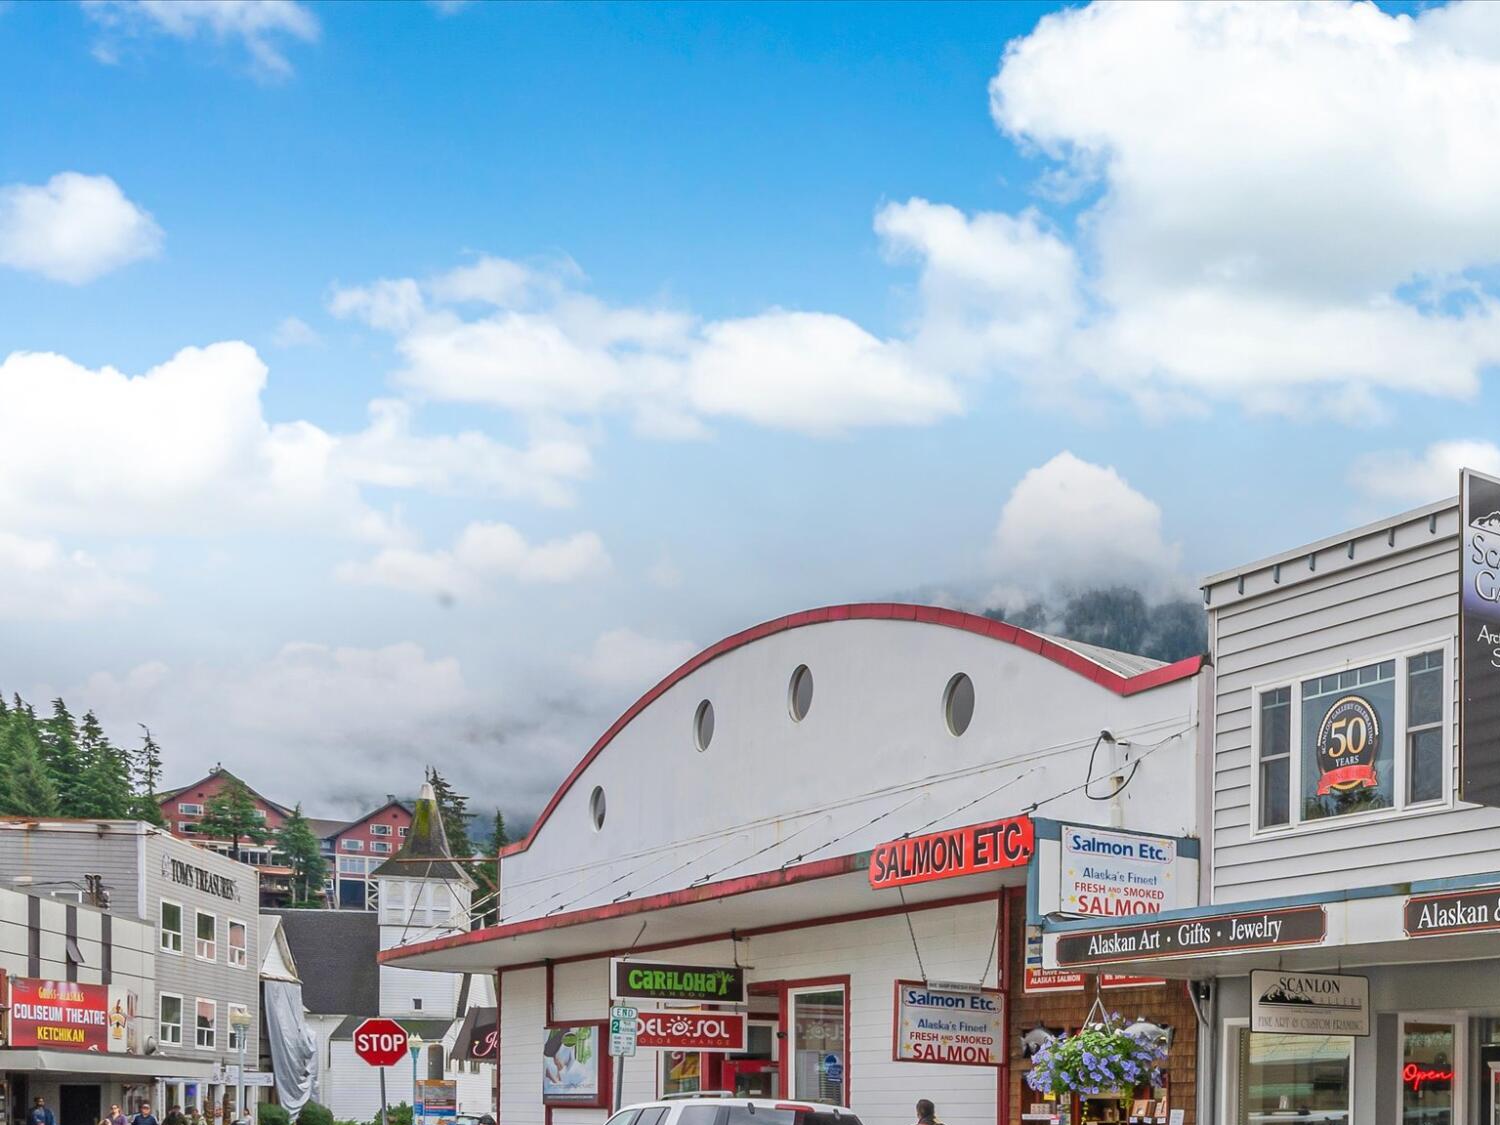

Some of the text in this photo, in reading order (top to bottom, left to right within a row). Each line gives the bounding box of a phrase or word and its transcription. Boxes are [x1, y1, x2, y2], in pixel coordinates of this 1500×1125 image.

[1328, 717, 1367, 757] 50
[1336, 755, 1360, 767] YEARS
[874, 822, 1030, 883] SALMON ETC.
[1072, 835, 1167, 861] Salmon Etc.
[171, 858, 234, 901] TOM'S TREASURES
[1083, 867, 1157, 885] Alaska's Finest
[1075, 882, 1105, 893] FRESH
[1124, 887, 1164, 900] SMOKED
[1078, 895, 1160, 916] SALMON
[1417, 902, 1489, 930] Alaskan
[1088, 916, 1282, 955] Alaskan Art Gifts Jewelry
[1280, 977, 1341, 993] SCANLON
[908, 991, 996, 1011] Salmon Etc.
[14, 1003, 105, 1025] COLISEUM THEATRE
[616, 1009, 634, 1017] END
[37, 1026, 85, 1042] KETCHIKAN
[693, 1020, 729, 1038] SOL
[917, 1019, 987, 1032] Alaska's Finest
[358, 1034, 404, 1052] STOP
[910, 1032, 938, 1041] FRESH
[955, 1034, 993, 1045] SMOKED
[913, 1043, 990, 1063] SALMON
[1403, 1064, 1455, 1091] Open
